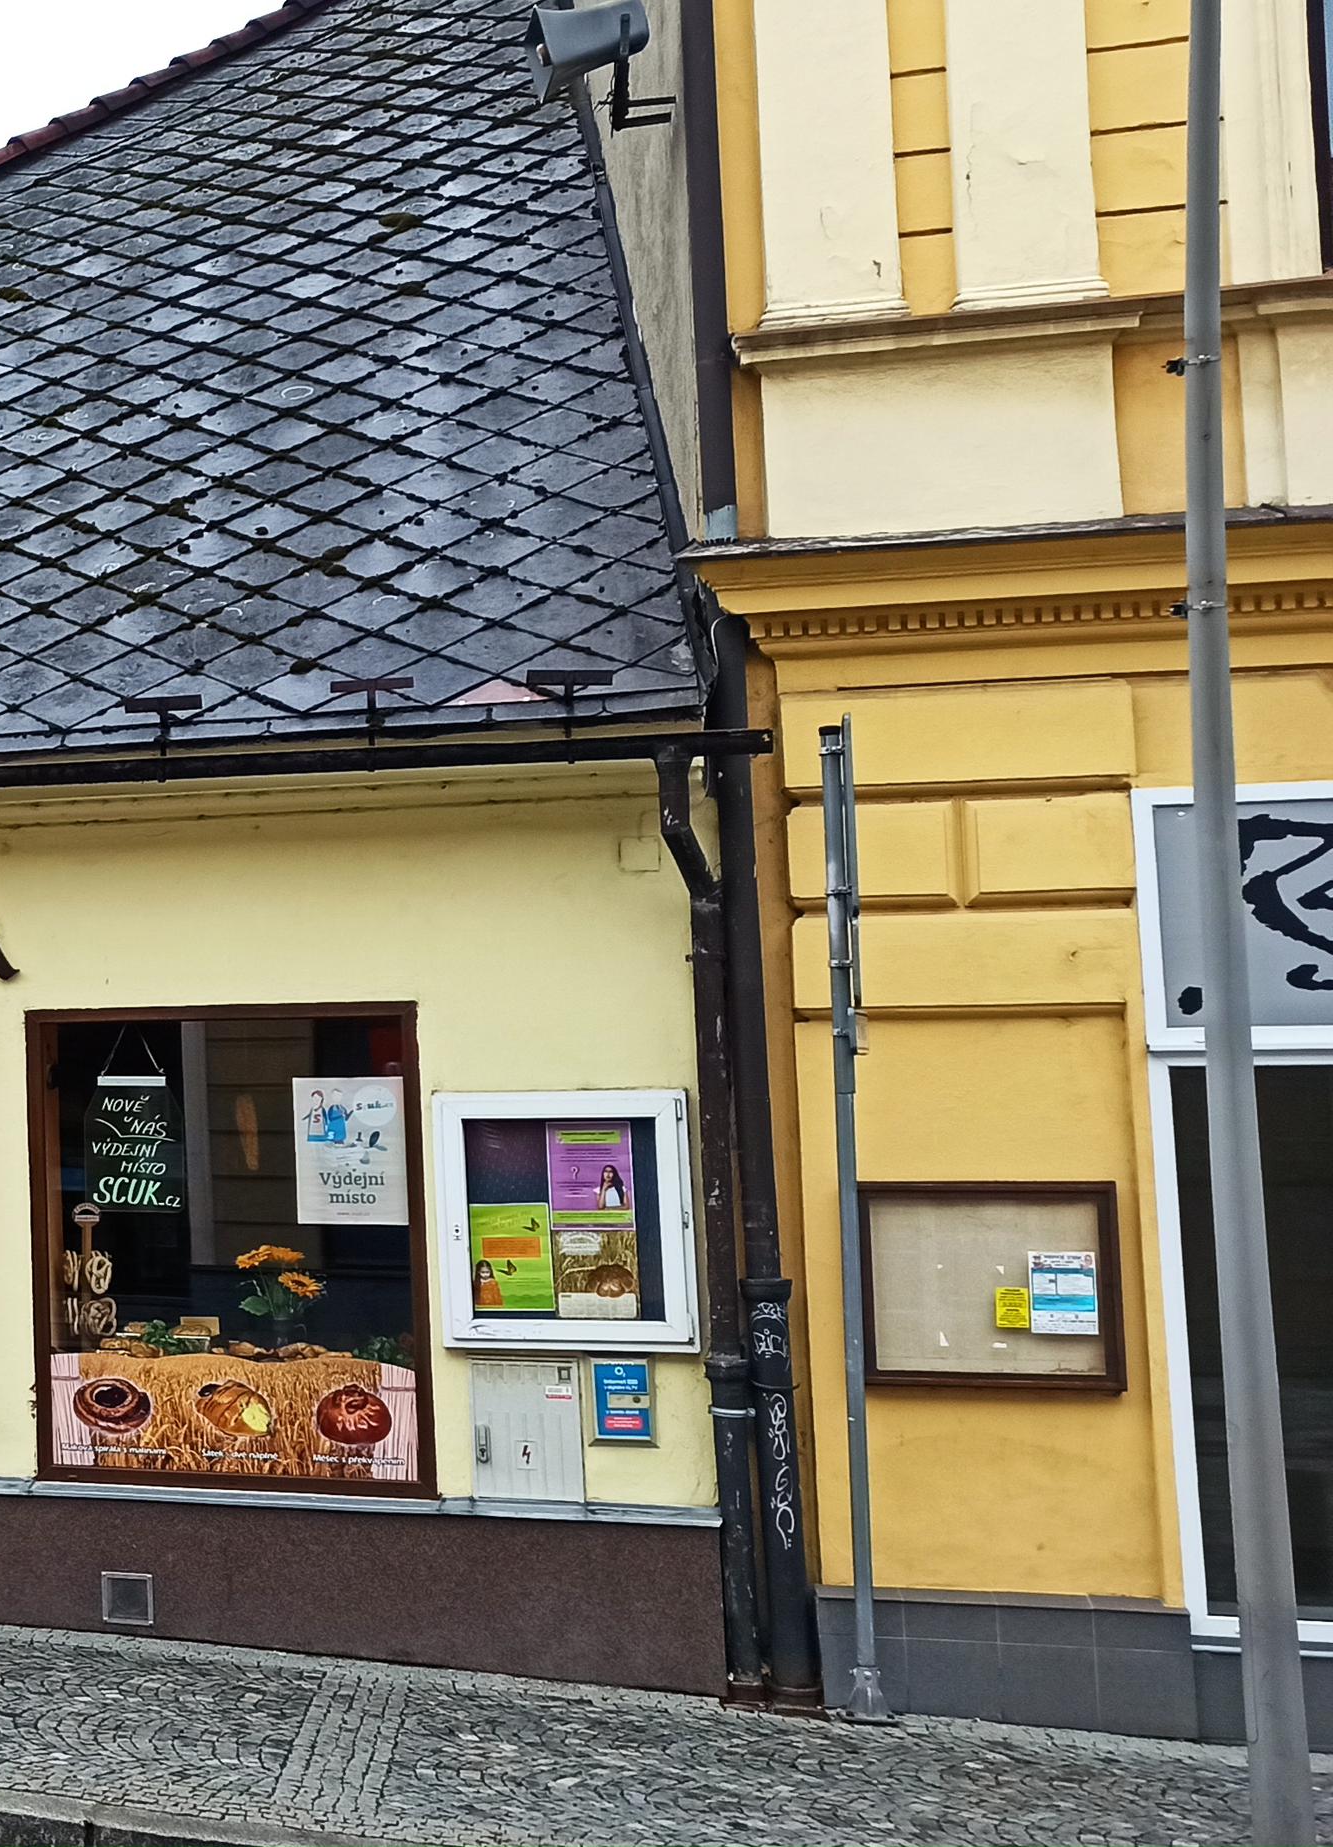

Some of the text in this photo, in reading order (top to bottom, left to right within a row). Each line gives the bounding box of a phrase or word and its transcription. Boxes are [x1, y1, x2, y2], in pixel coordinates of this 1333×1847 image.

[130, 1114, 168, 1138] NÁS
[92, 1138, 162, 1158] VÝDEJNÍ
[319, 1170, 385, 1189] Výdejní
[329, 1189, 377, 1204] místo
